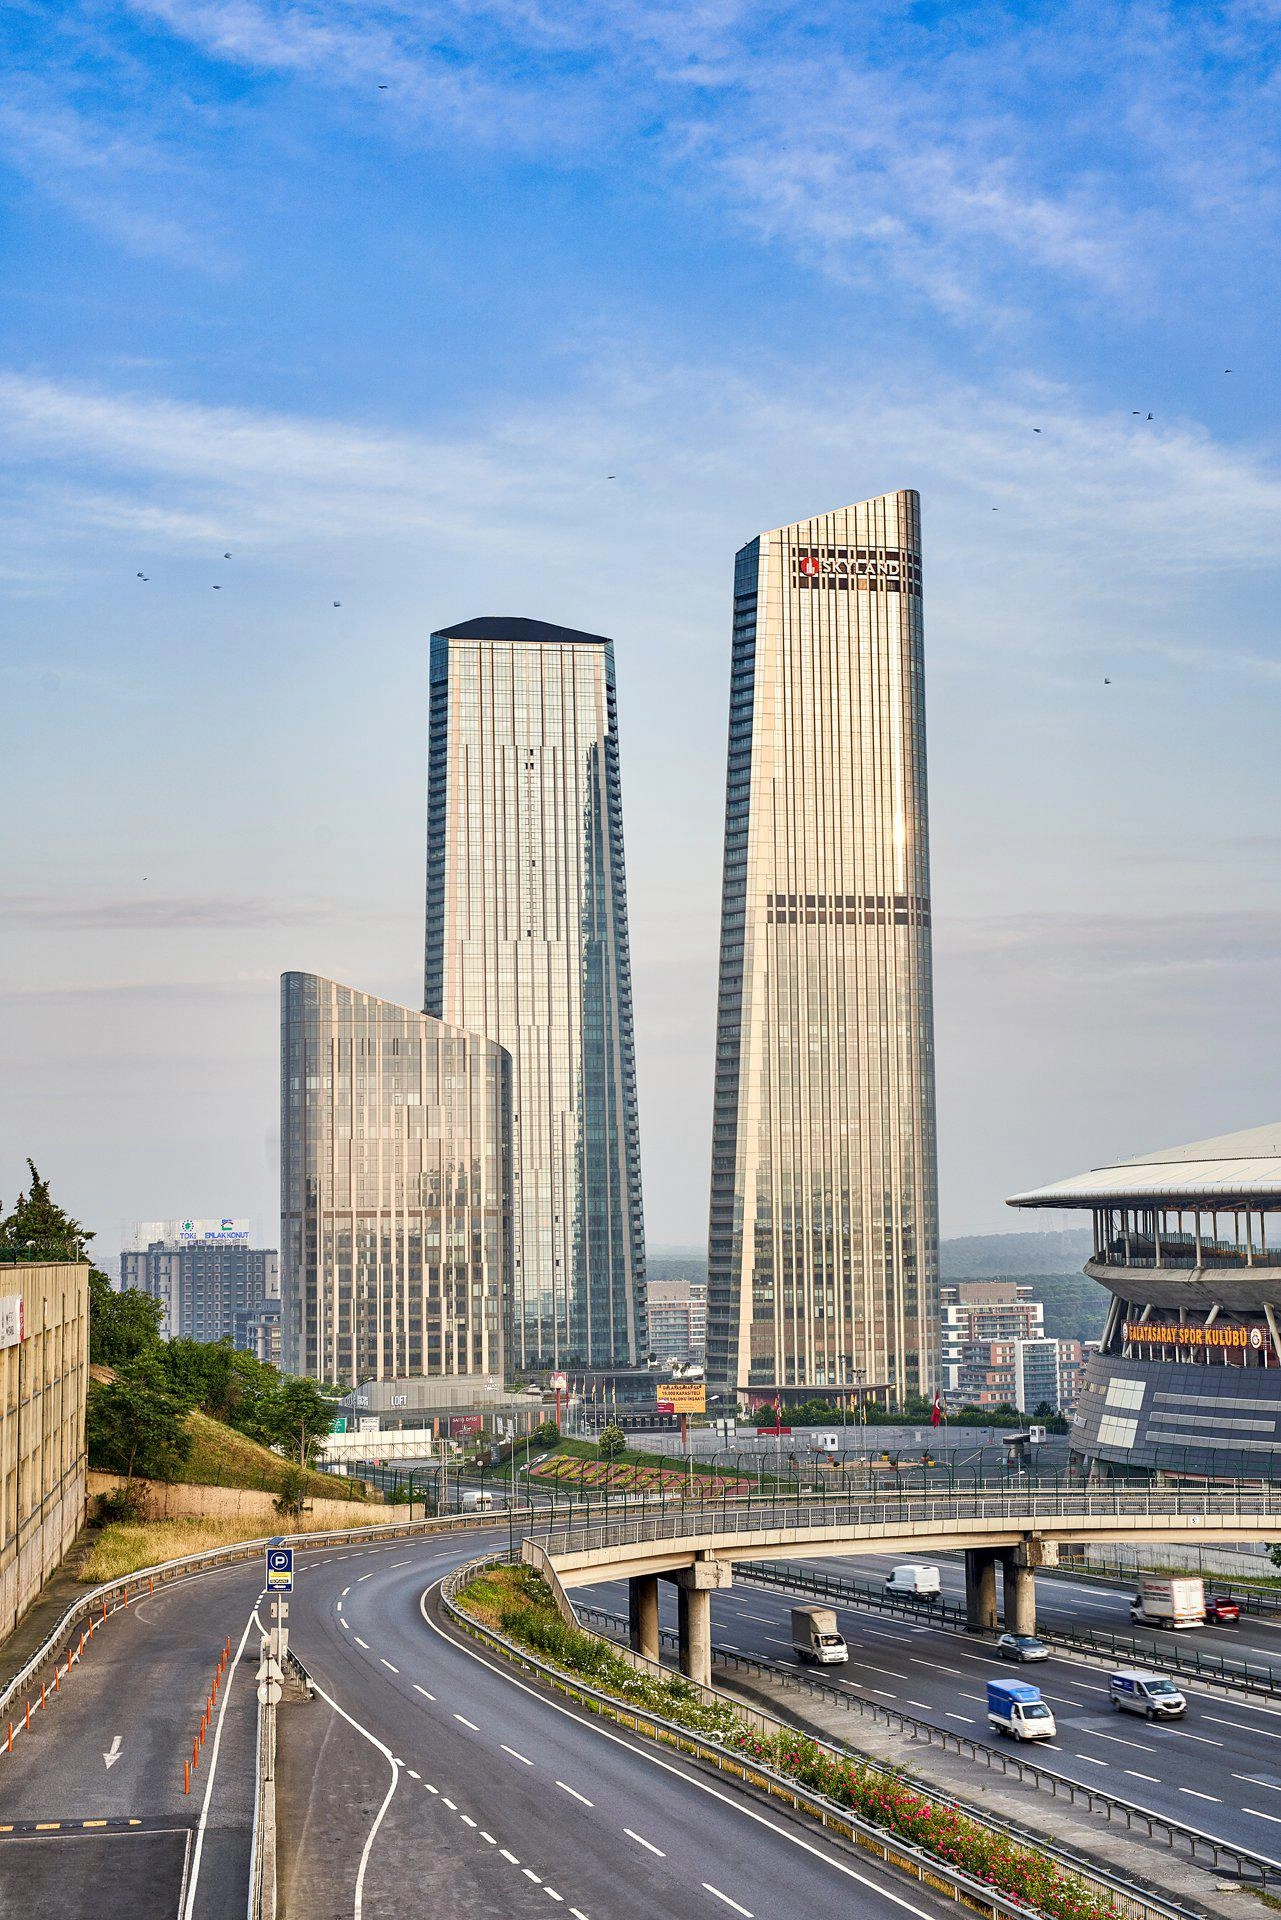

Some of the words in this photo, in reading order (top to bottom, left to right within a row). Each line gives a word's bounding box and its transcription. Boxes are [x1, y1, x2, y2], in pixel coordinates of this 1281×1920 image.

[822, 561, 899, 575] SKYLAND
[1128, 1325, 1176, 1343] GALATASARAY
[1179, 1328, 1203, 1345] SPOR
[1205, 1327, 1247, 1347] KULÜBÜ
[391, 1395, 408, 1406] LOFT
[275, 1556, 285, 1567] P
